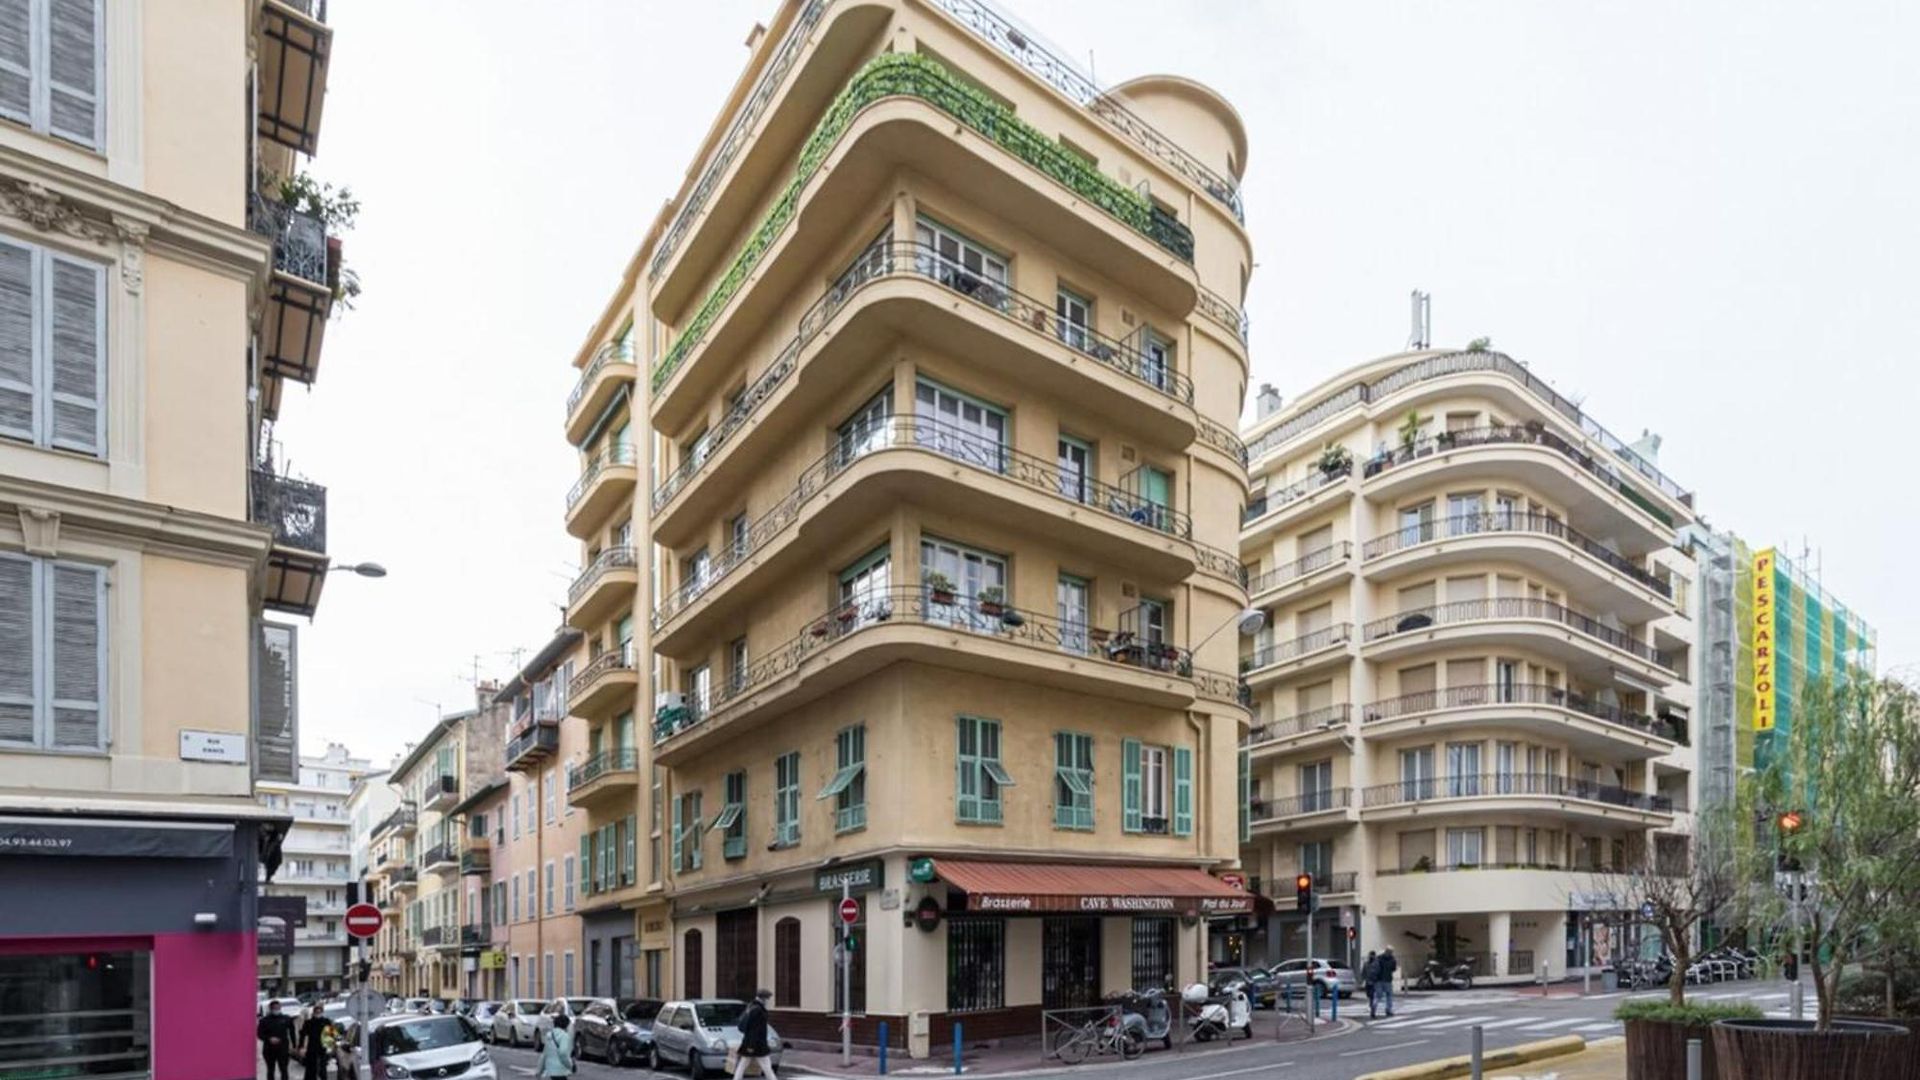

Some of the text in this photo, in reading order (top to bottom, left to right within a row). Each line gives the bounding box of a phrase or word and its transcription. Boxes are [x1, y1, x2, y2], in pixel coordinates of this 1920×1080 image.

[1756, 557, 1771, 728] PESCARZOLI
[819, 868, 872, 892] BRASSERIE
[981, 896, 1031, 909] Brasserie
[1080, 897, 1175, 910] CAVE WASHINGTON
